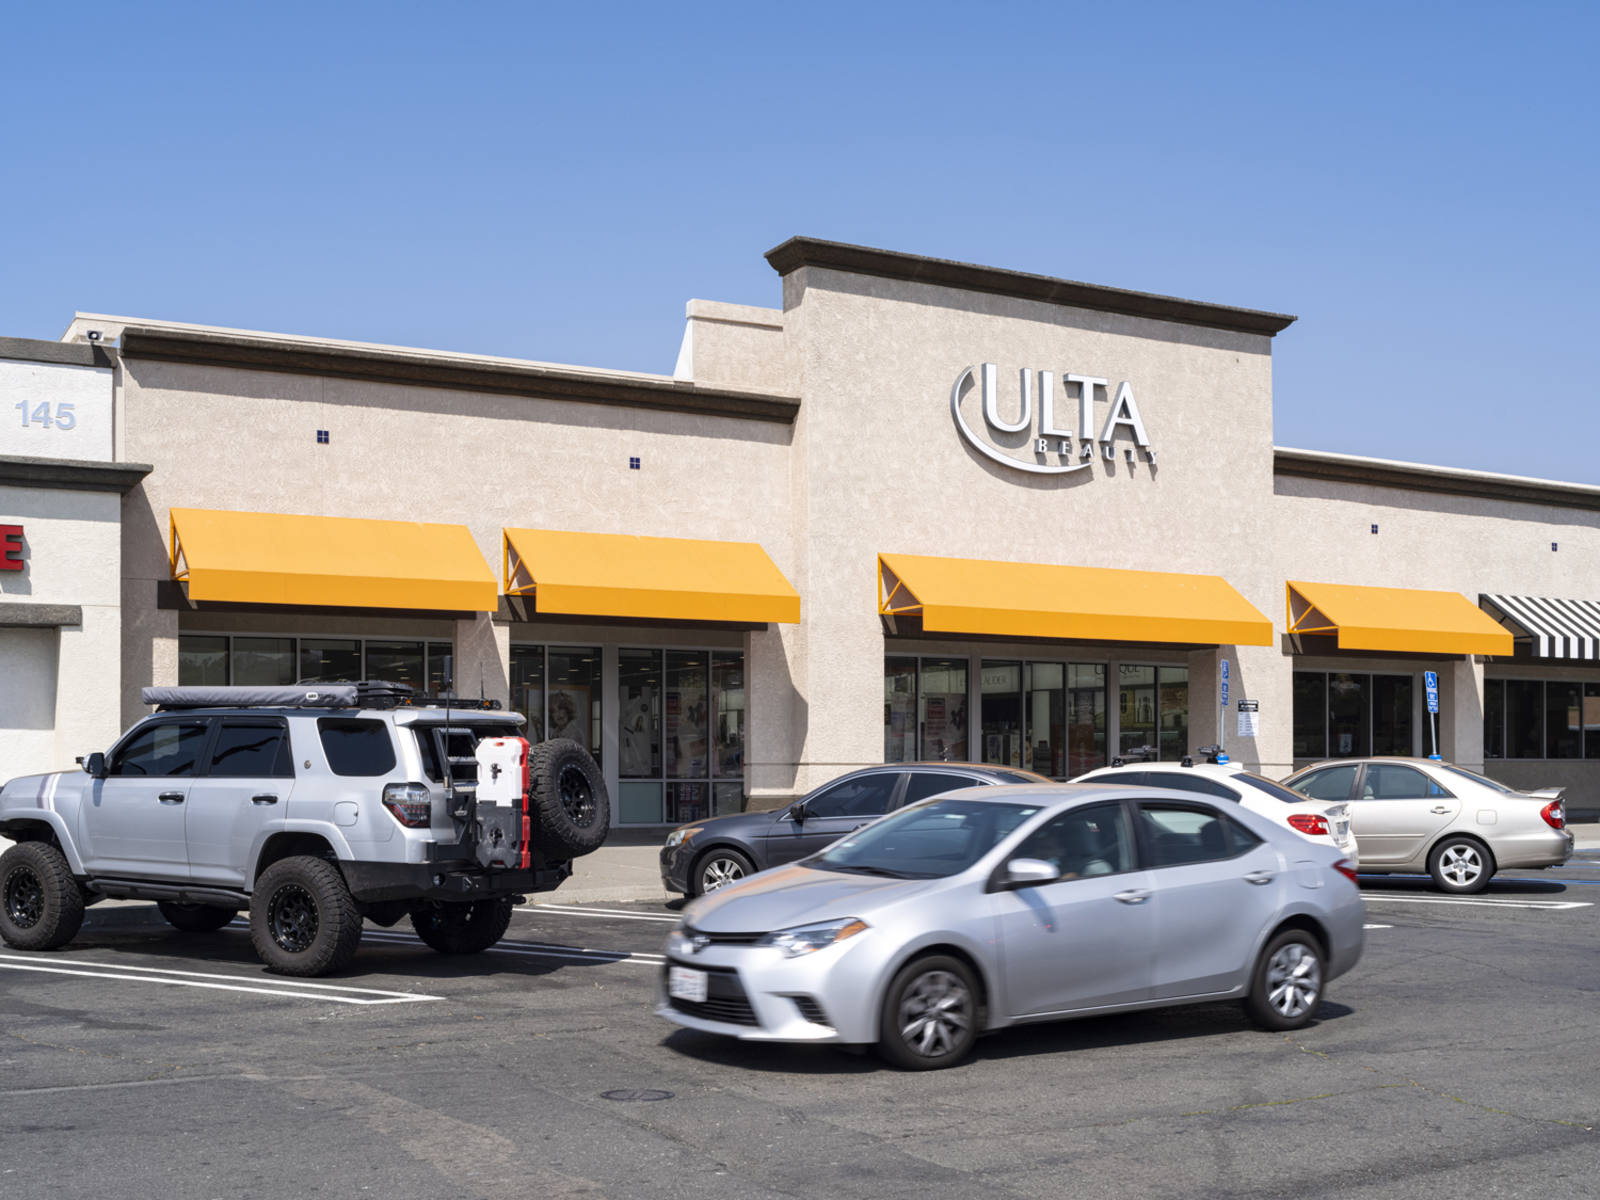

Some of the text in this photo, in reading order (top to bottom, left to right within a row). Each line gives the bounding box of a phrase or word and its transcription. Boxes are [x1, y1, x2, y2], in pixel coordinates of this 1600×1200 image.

[15, 399, 76, 430] 145
[981, 362, 1150, 447] ULTA
[1034, 438, 1157, 465] BEAUTY
